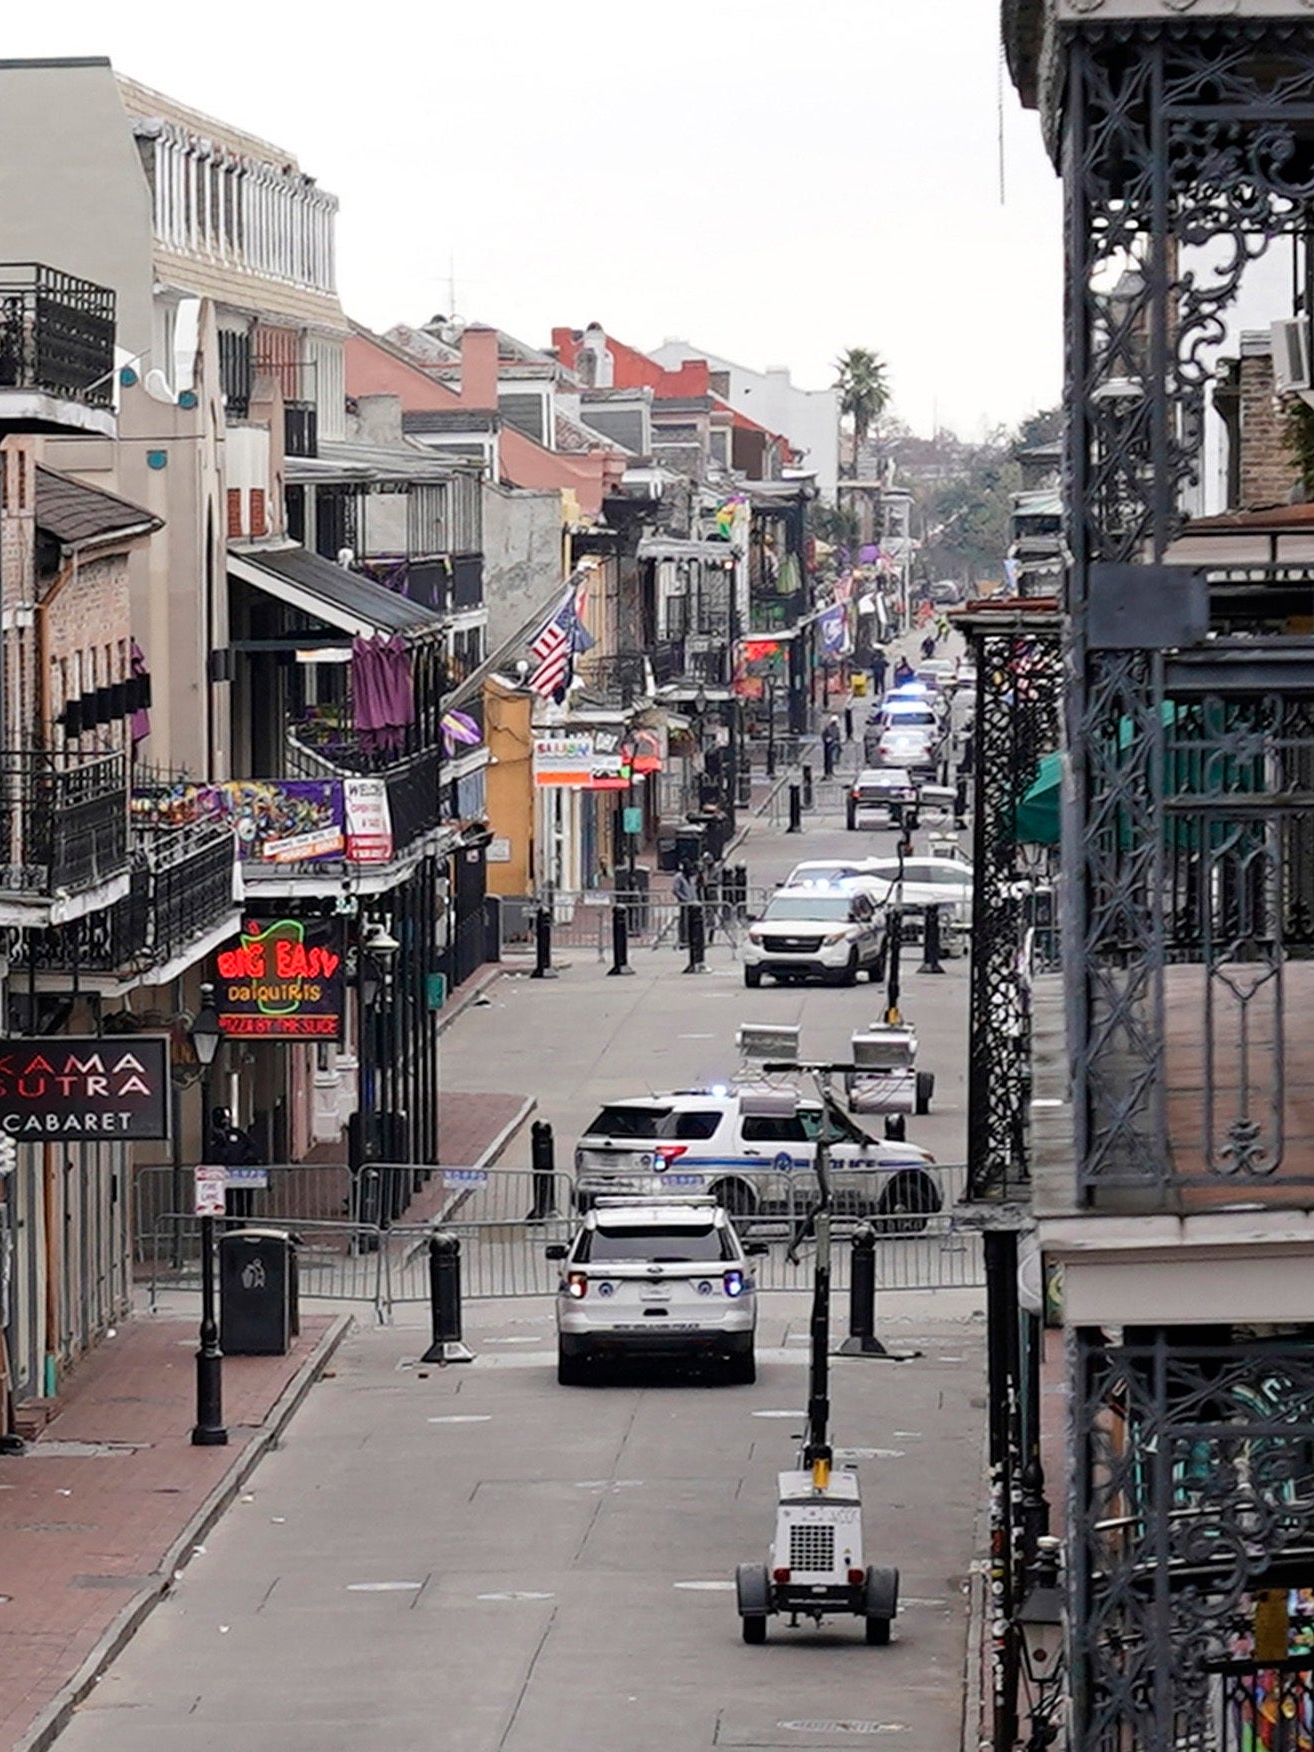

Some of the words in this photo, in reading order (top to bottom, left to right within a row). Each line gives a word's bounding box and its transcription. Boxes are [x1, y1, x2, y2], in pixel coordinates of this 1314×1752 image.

[218, 942, 265, 978] BIG
[276, 940, 339, 978] EASY
[3, 1113, 132, 1131] CABARET
